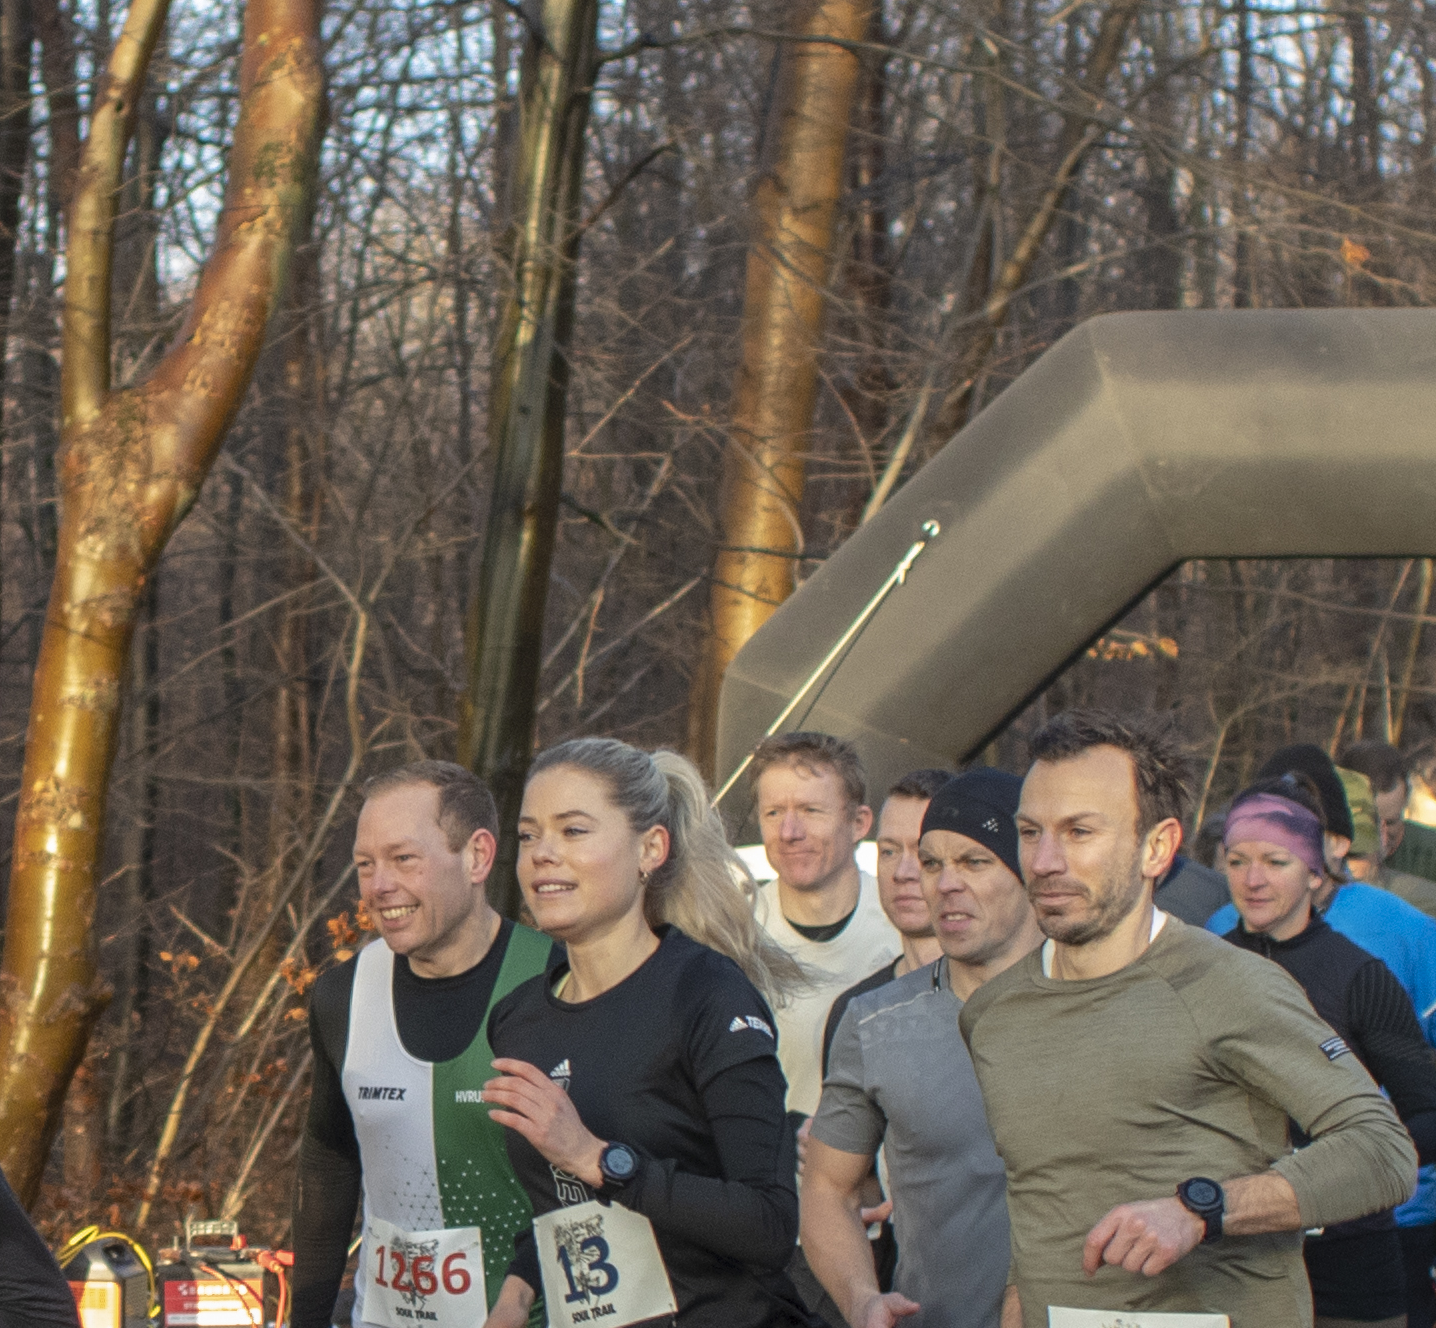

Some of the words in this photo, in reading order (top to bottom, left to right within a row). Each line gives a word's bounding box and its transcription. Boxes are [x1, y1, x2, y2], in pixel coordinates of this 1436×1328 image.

[358, 1086, 407, 1101] TRIMTEX
[455, 1090, 485, 1103] HVRU
[375, 1245, 472, 1296] 1266
[557, 1235, 619, 1304] 13
[396, 1306, 414, 1319] SOUL
[415, 1309, 438, 1321] TRAIL
[591, 1303, 617, 1320] TRAIL
